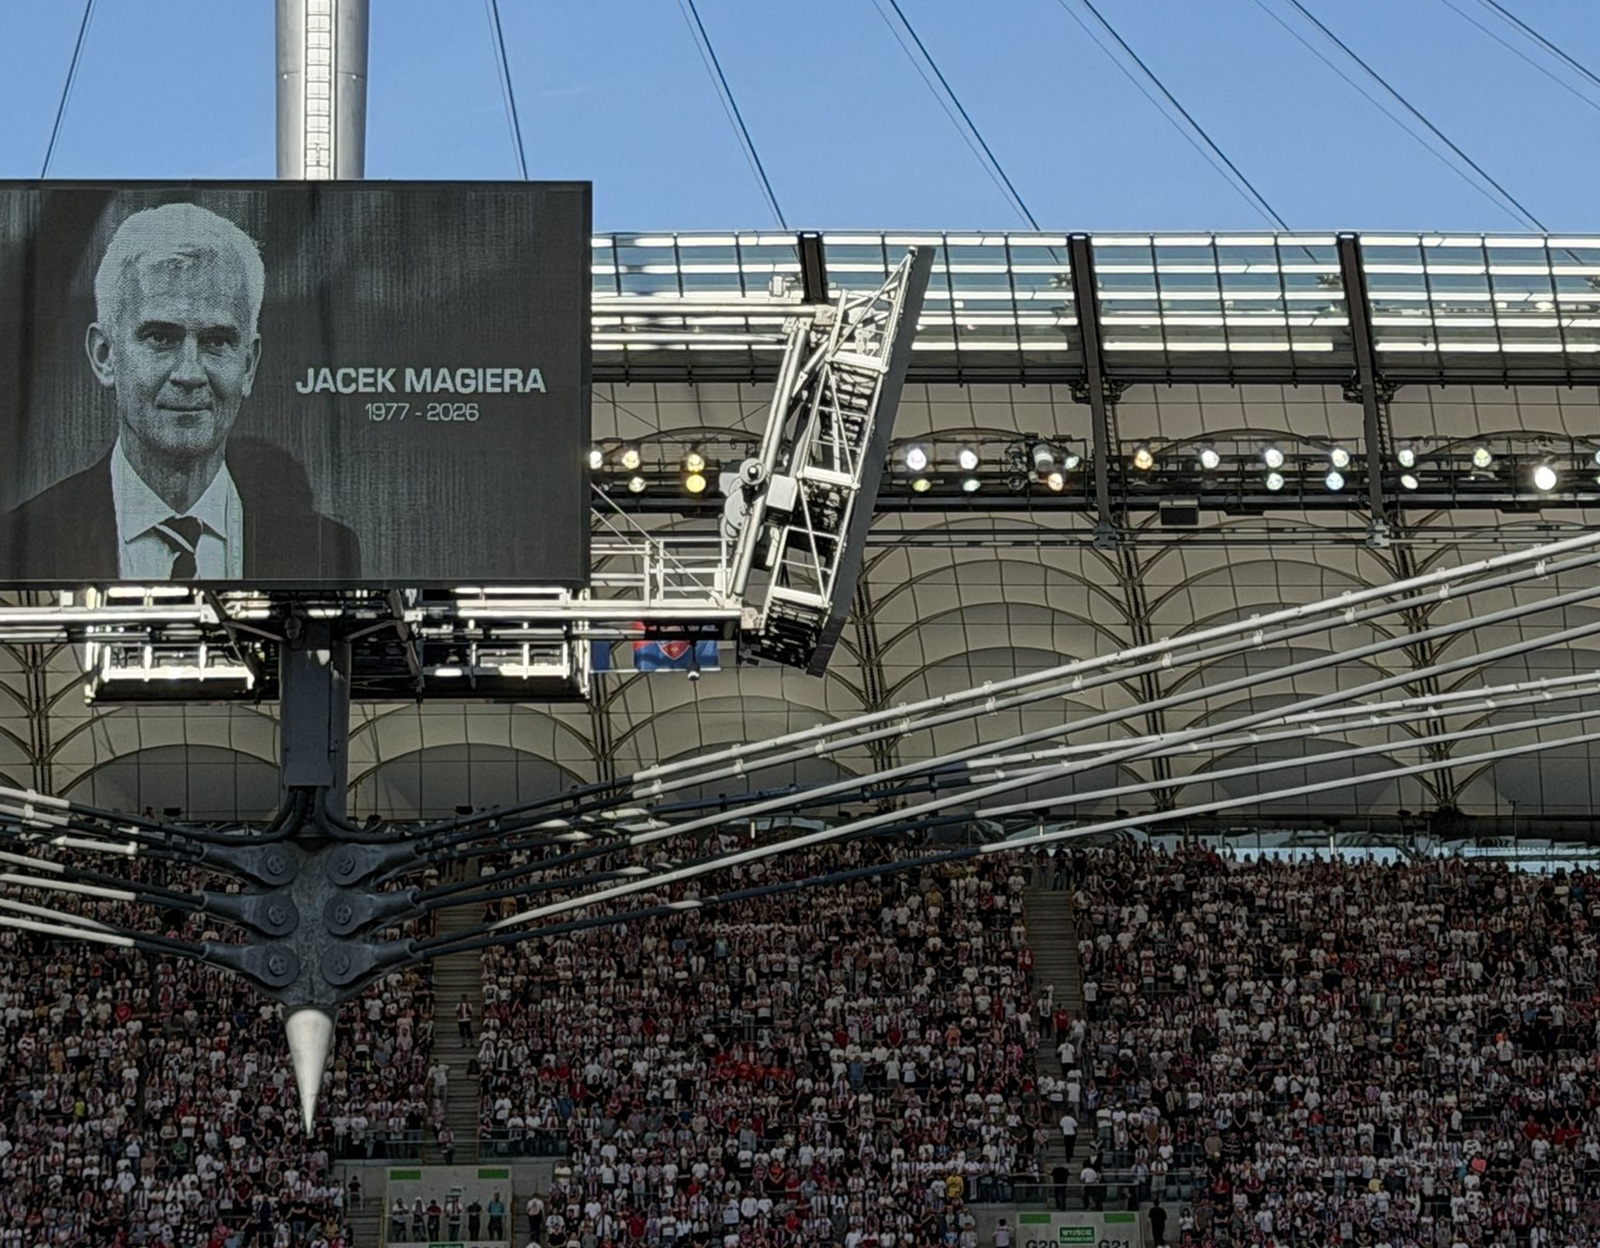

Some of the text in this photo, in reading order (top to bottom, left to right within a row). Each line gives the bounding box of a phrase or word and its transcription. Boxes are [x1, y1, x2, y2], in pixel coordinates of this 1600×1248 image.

[295, 367, 547, 394] JACEK MAGIERA
[364, 403, 410, 421] 1977
[426, 403, 480, 421] 2026
